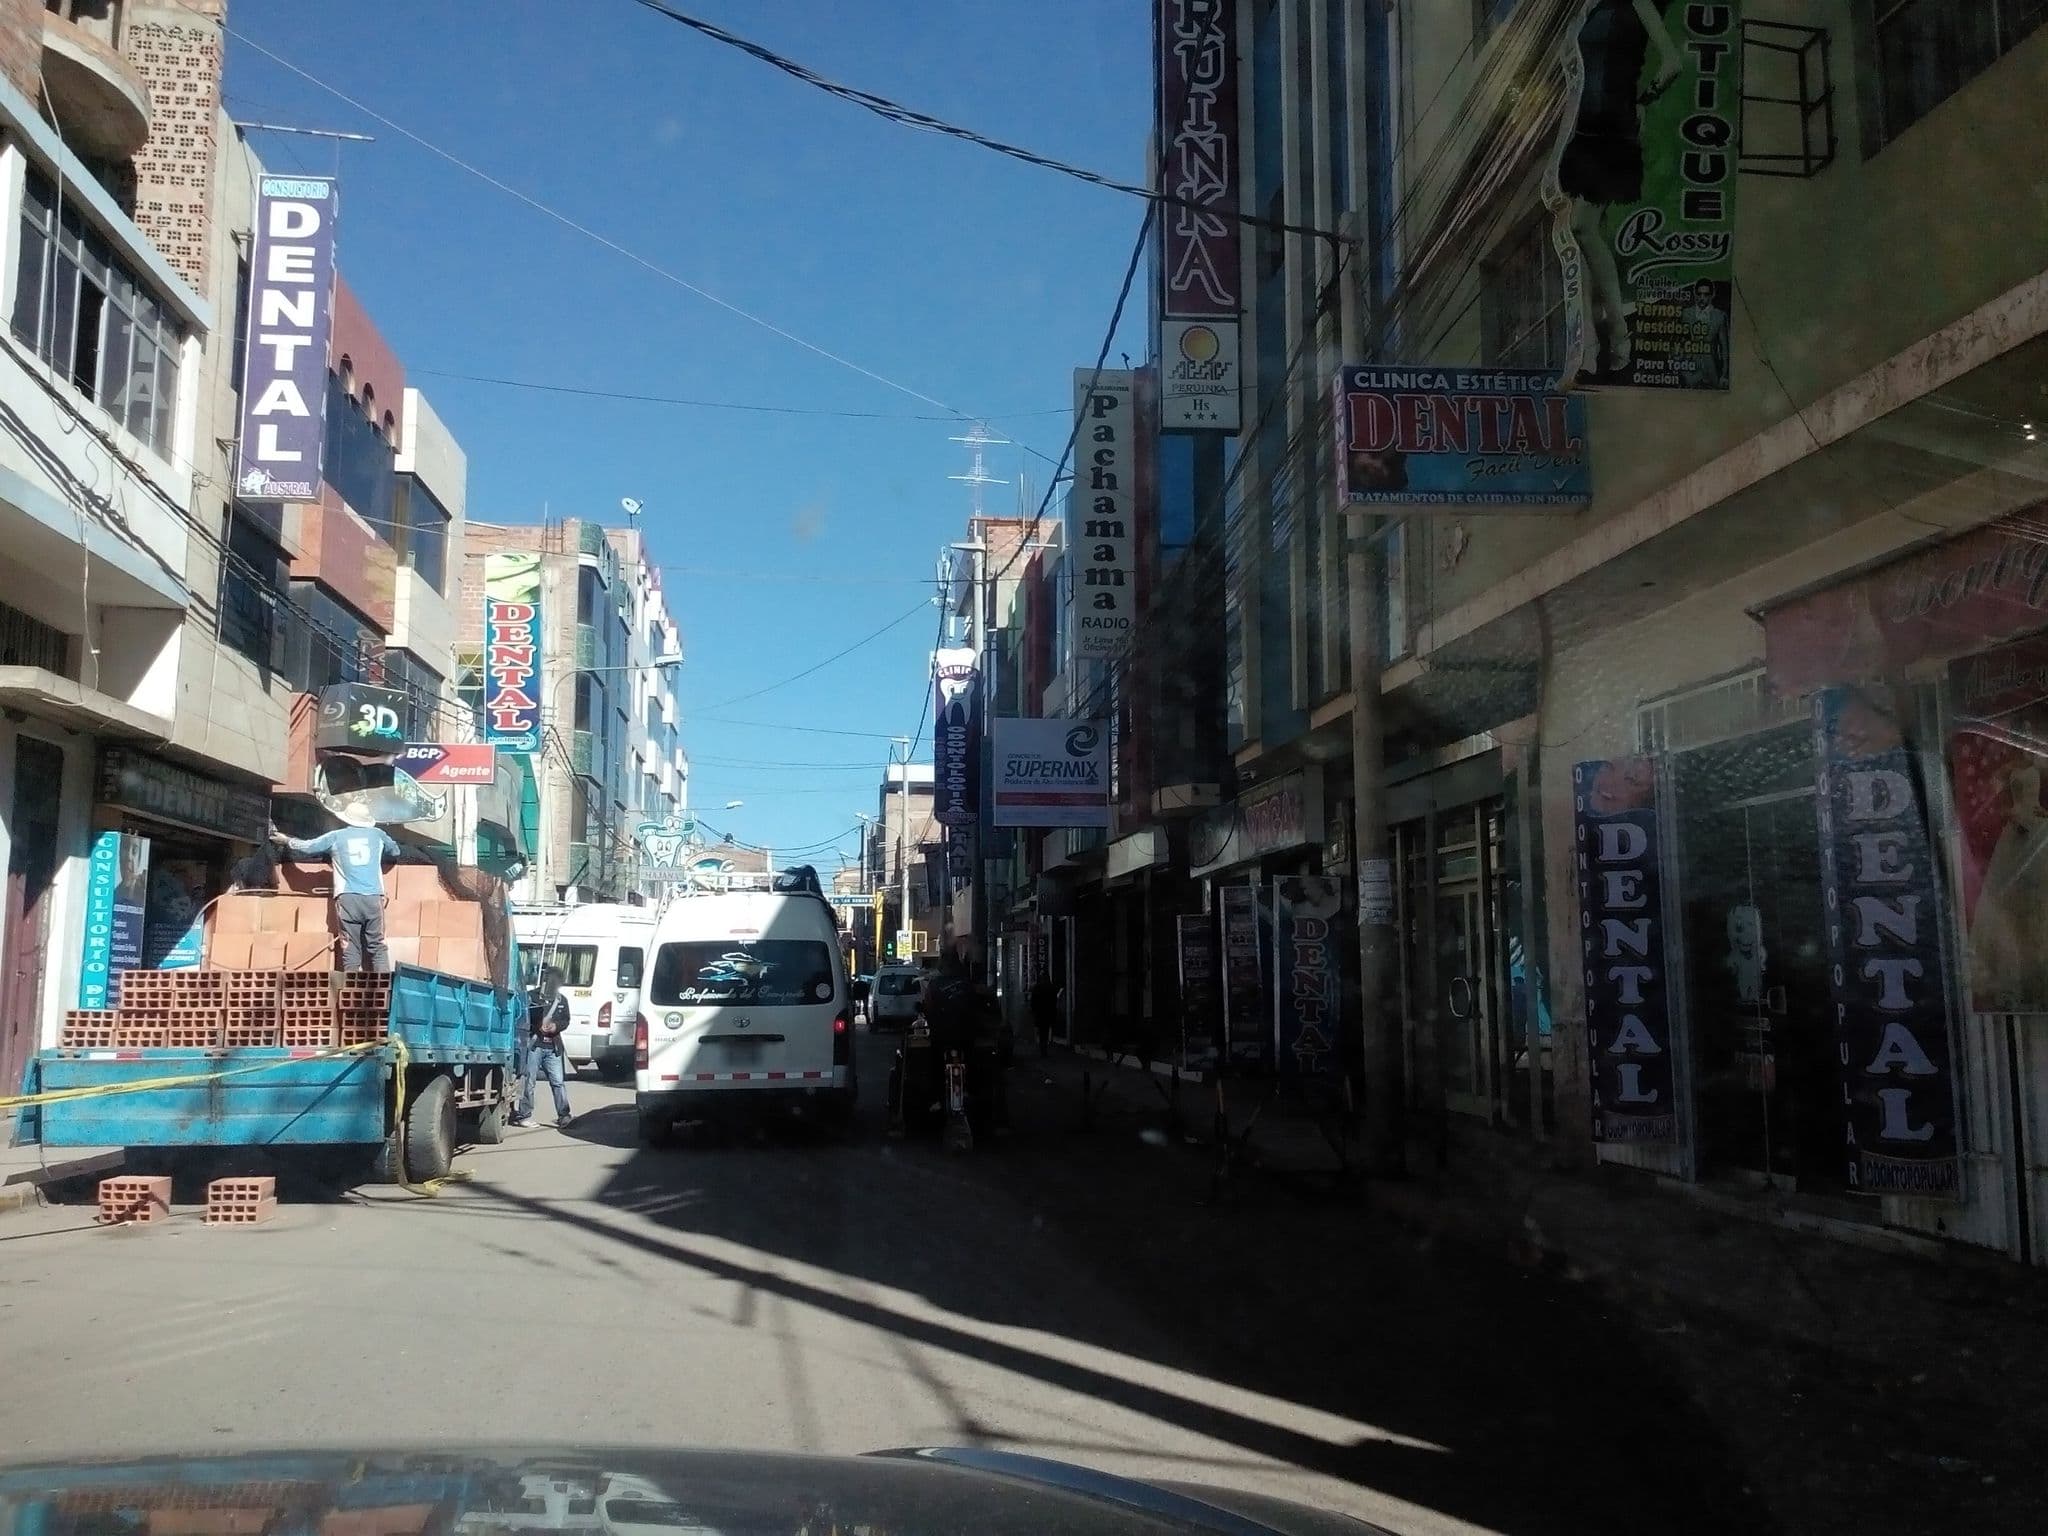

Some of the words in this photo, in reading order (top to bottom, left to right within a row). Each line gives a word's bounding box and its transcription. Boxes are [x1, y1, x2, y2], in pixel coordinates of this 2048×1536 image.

[262, 179, 330, 199] CONSULTORIO
[1617, 208, 1731, 262] Rossy
[1636, 303, 1683, 317] Ternos
[251, 200, 322, 463] DENTAL
[1636, 320, 1690, 334] Vestidos
[1635, 339, 1670, 352] Novia
[1636, 359, 1665, 370] Para
[1667, 359, 1697, 371] Toda
[1354, 371, 1449, 390] CLINICA
[1456, 371, 1560, 392] ESTÉTICA
[1347, 392, 1582, 455] DENTAL
[264, 481, 312, 496] AUSTRAL
[1348, 491, 1444, 503] TRATAMIENTOS
[1448, 493, 1463, 503] DE
[1467, 493, 1522, 504] CALIDAD
[1084, 393, 1126, 611] Pachamama
[1081, 617, 1130, 629] RADIO
[487, 603, 537, 731] DENTAL
[359, 704, 400, 735] 3D
[406, 748, 438, 759] BCP
[440, 765, 490, 778] Agente
[1005, 760, 1099, 778] SUPERMIX
[348, 838, 371, 866] 5
[86, 837, 114, 973] CONSULTORIO
[1598, 822, 1663, 1105] DENTAL
[1847, 769, 1939, 1143] DENTAL
[86, 984, 104, 1008] DE
